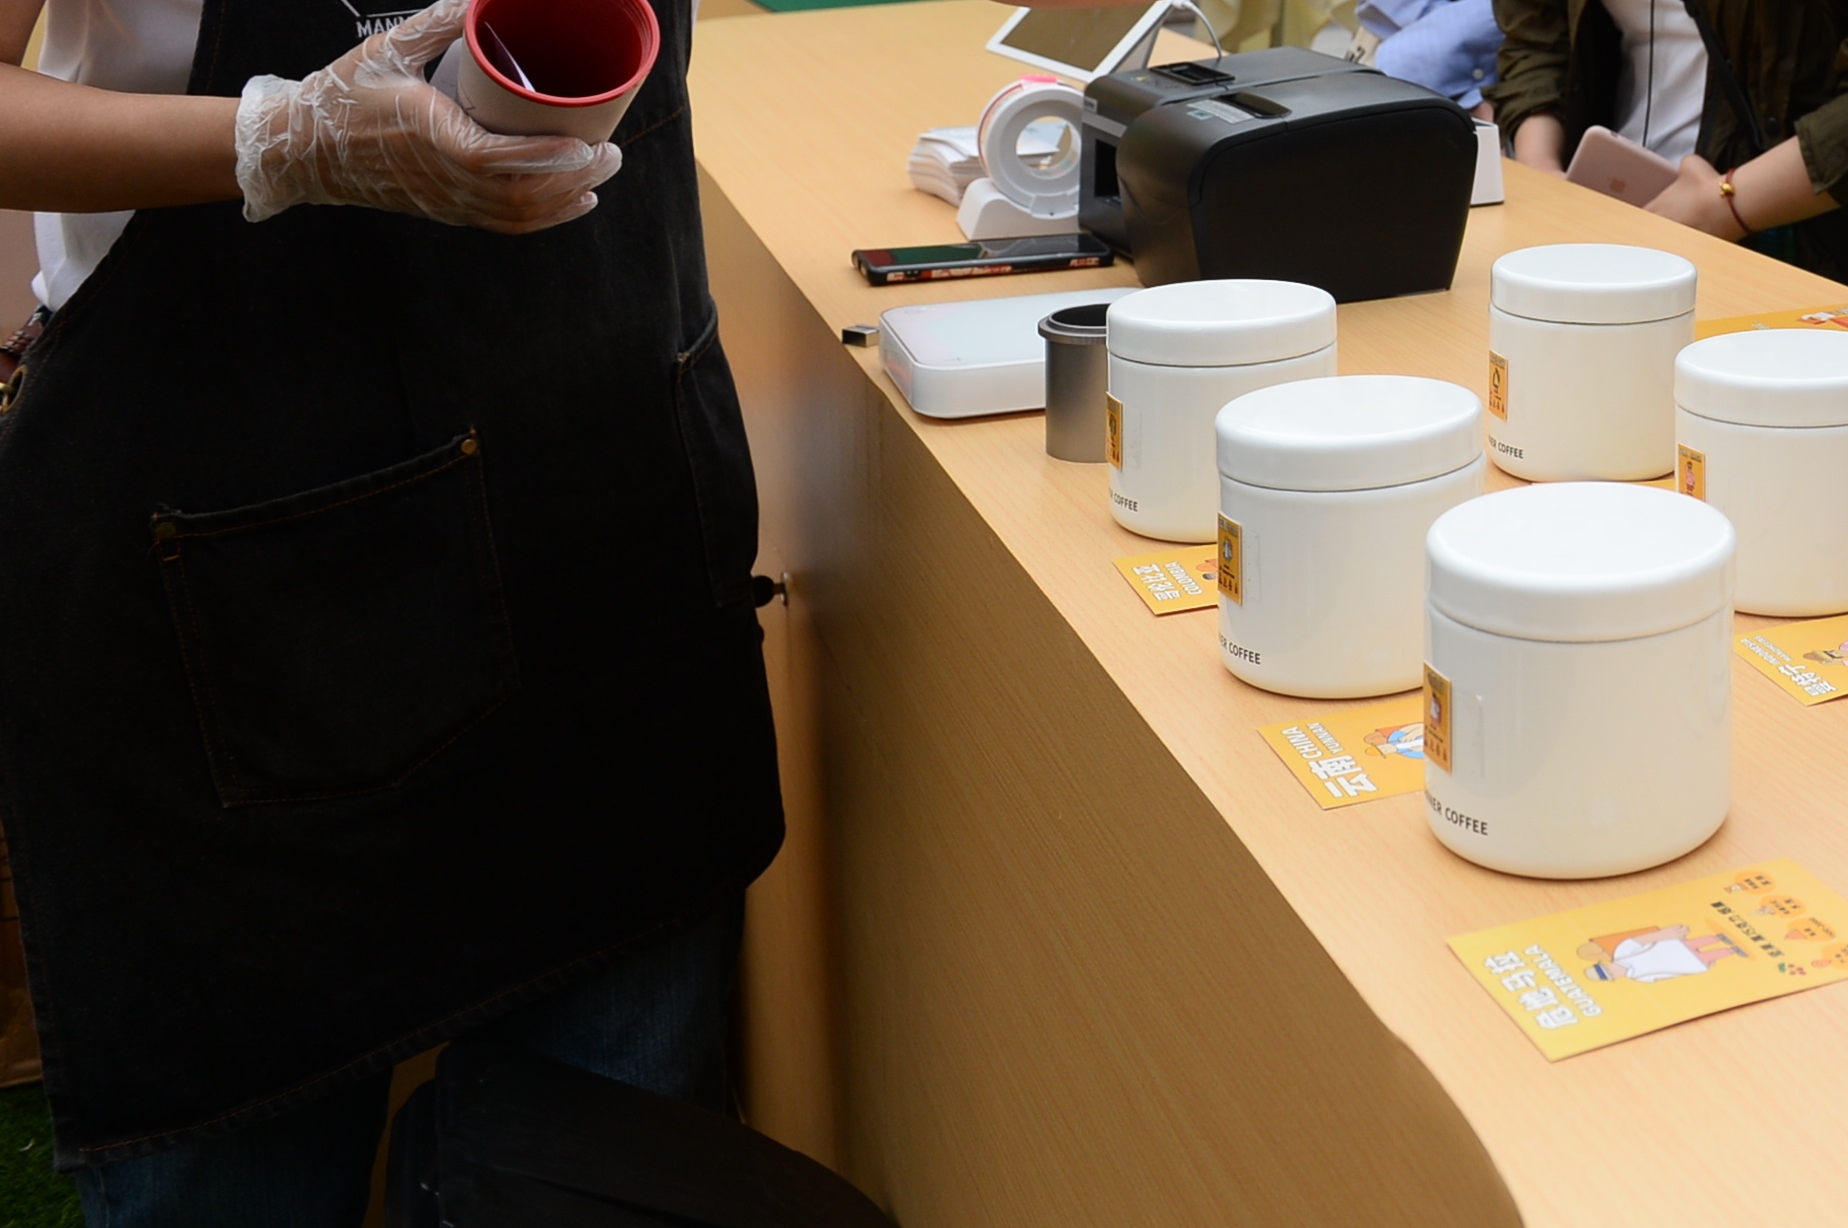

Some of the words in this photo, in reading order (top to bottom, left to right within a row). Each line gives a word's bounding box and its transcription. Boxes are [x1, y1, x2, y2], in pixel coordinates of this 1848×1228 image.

[1497, 441, 1524, 460] COFFEE
[1113, 492, 1139, 513] COFFEE
[1163, 560, 1204, 595] COLOMBIA
[1228, 641, 1262, 666] COFFEE
[1776, 663, 1838, 698] 曼特宁
[1281, 725, 1324, 760] CHINA
[1305, 721, 1345, 755] YUNNAN
[1307, 754, 1379, 799] 云南
[1444, 806, 1489, 837] COFFEE
[1483, 950, 1580, 1030] 危地马拉
[1522, 943, 1604, 1018] GUATEMALA
